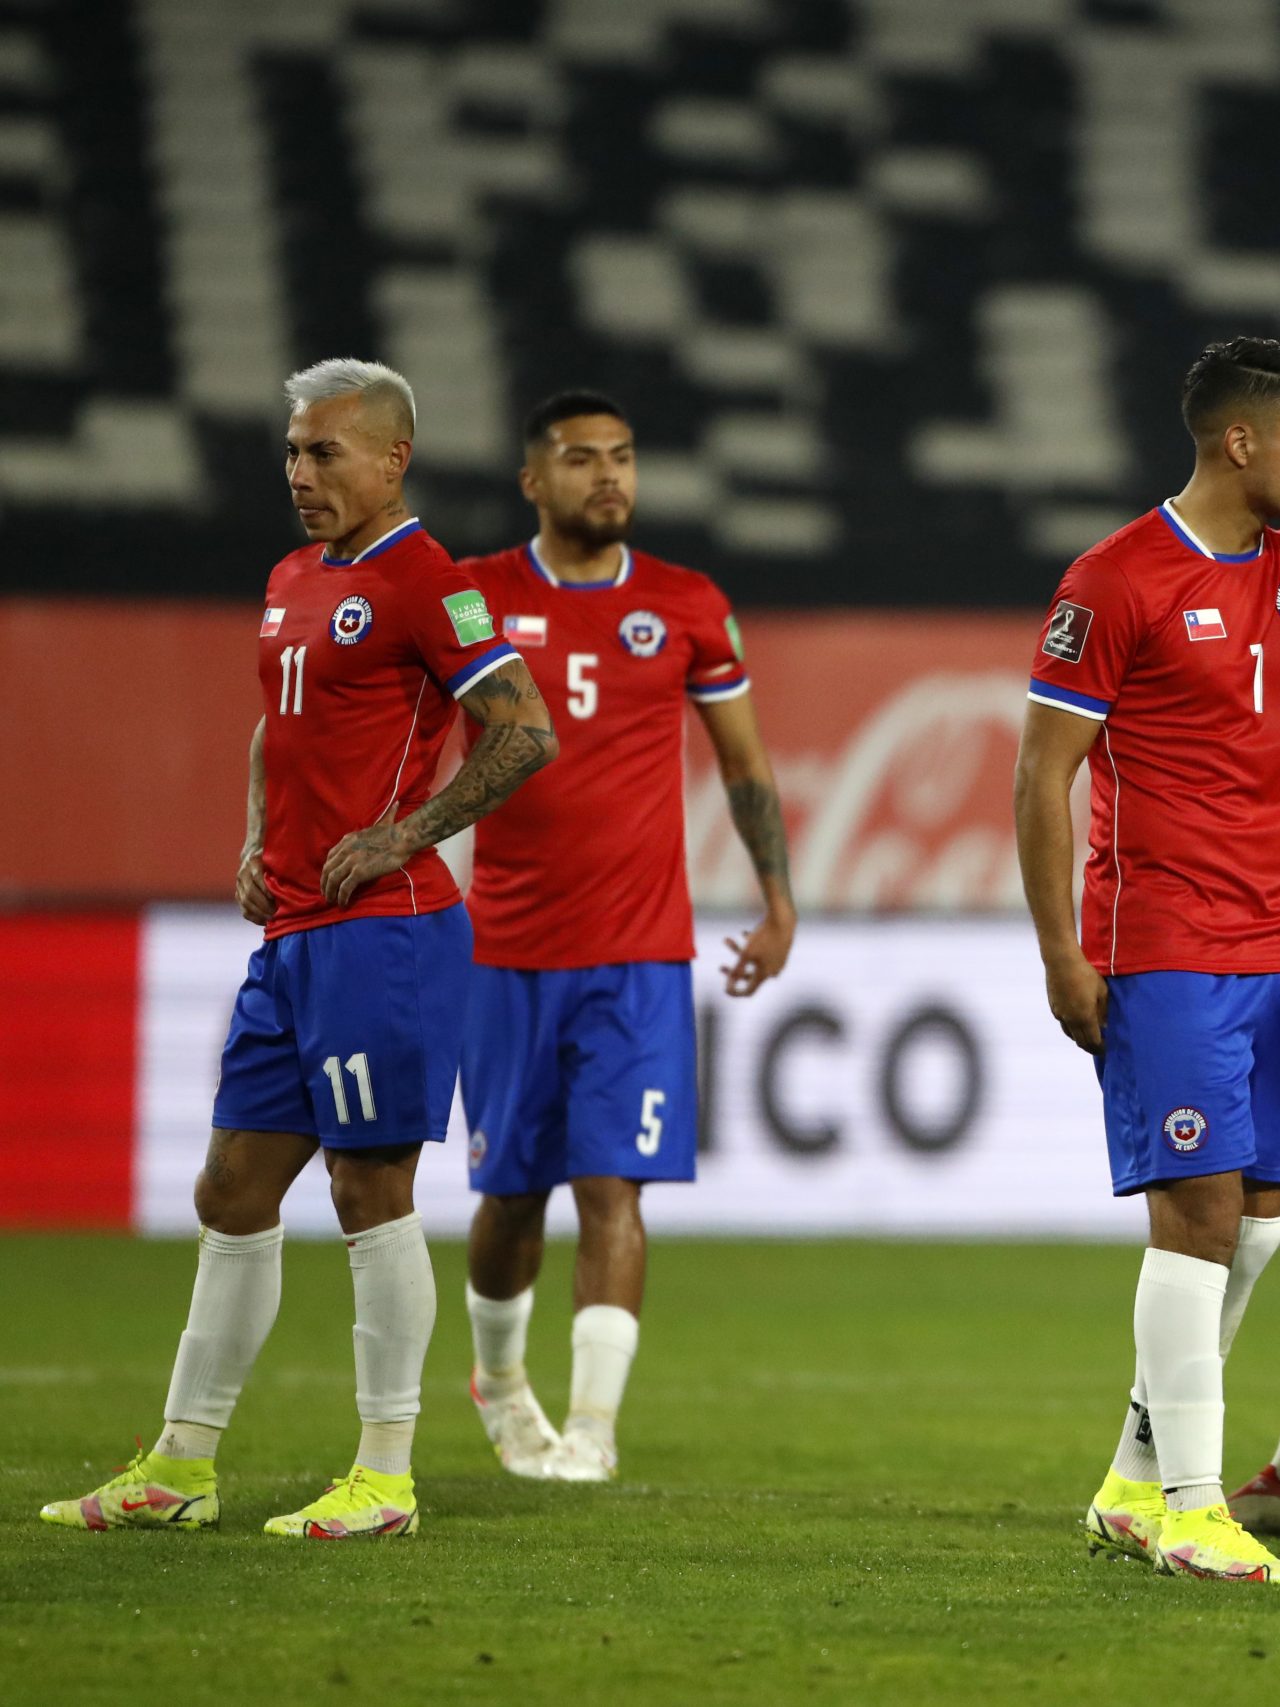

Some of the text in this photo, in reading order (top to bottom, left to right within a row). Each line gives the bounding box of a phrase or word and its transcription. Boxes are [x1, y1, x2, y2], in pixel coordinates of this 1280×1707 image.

[279, 645, 307, 715] 11
[567, 653, 598, 719] 5
[322, 1052, 375, 1123] 11
[635, 1089, 666, 1157] 5
